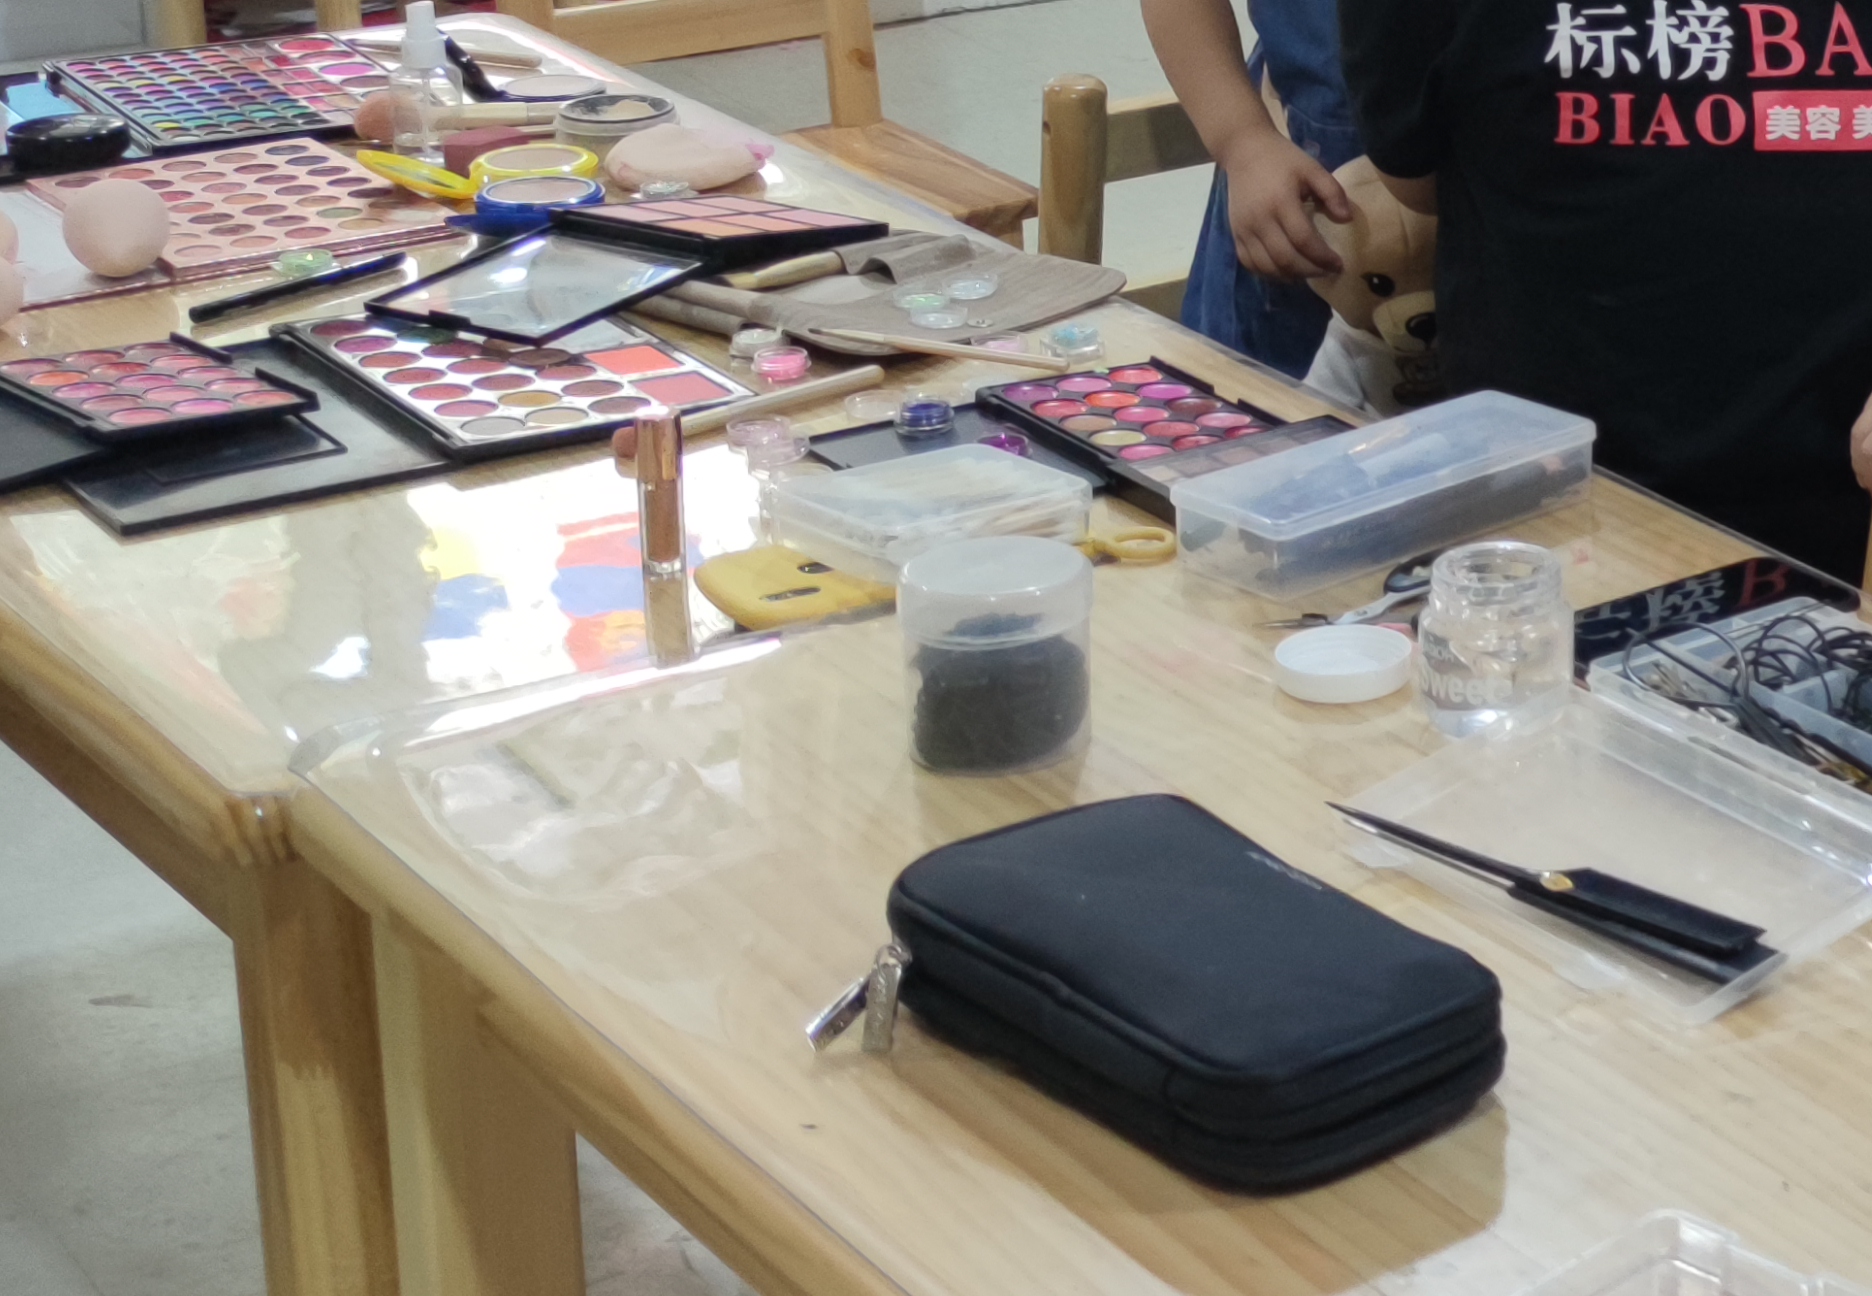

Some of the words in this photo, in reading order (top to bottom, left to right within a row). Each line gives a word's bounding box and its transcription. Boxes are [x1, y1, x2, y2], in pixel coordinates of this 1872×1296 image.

[1544, 0, 1734, 81] 标榜
[1554, 92, 1746, 146] BIAO
[1765, 105, 1841, 140] 美容
